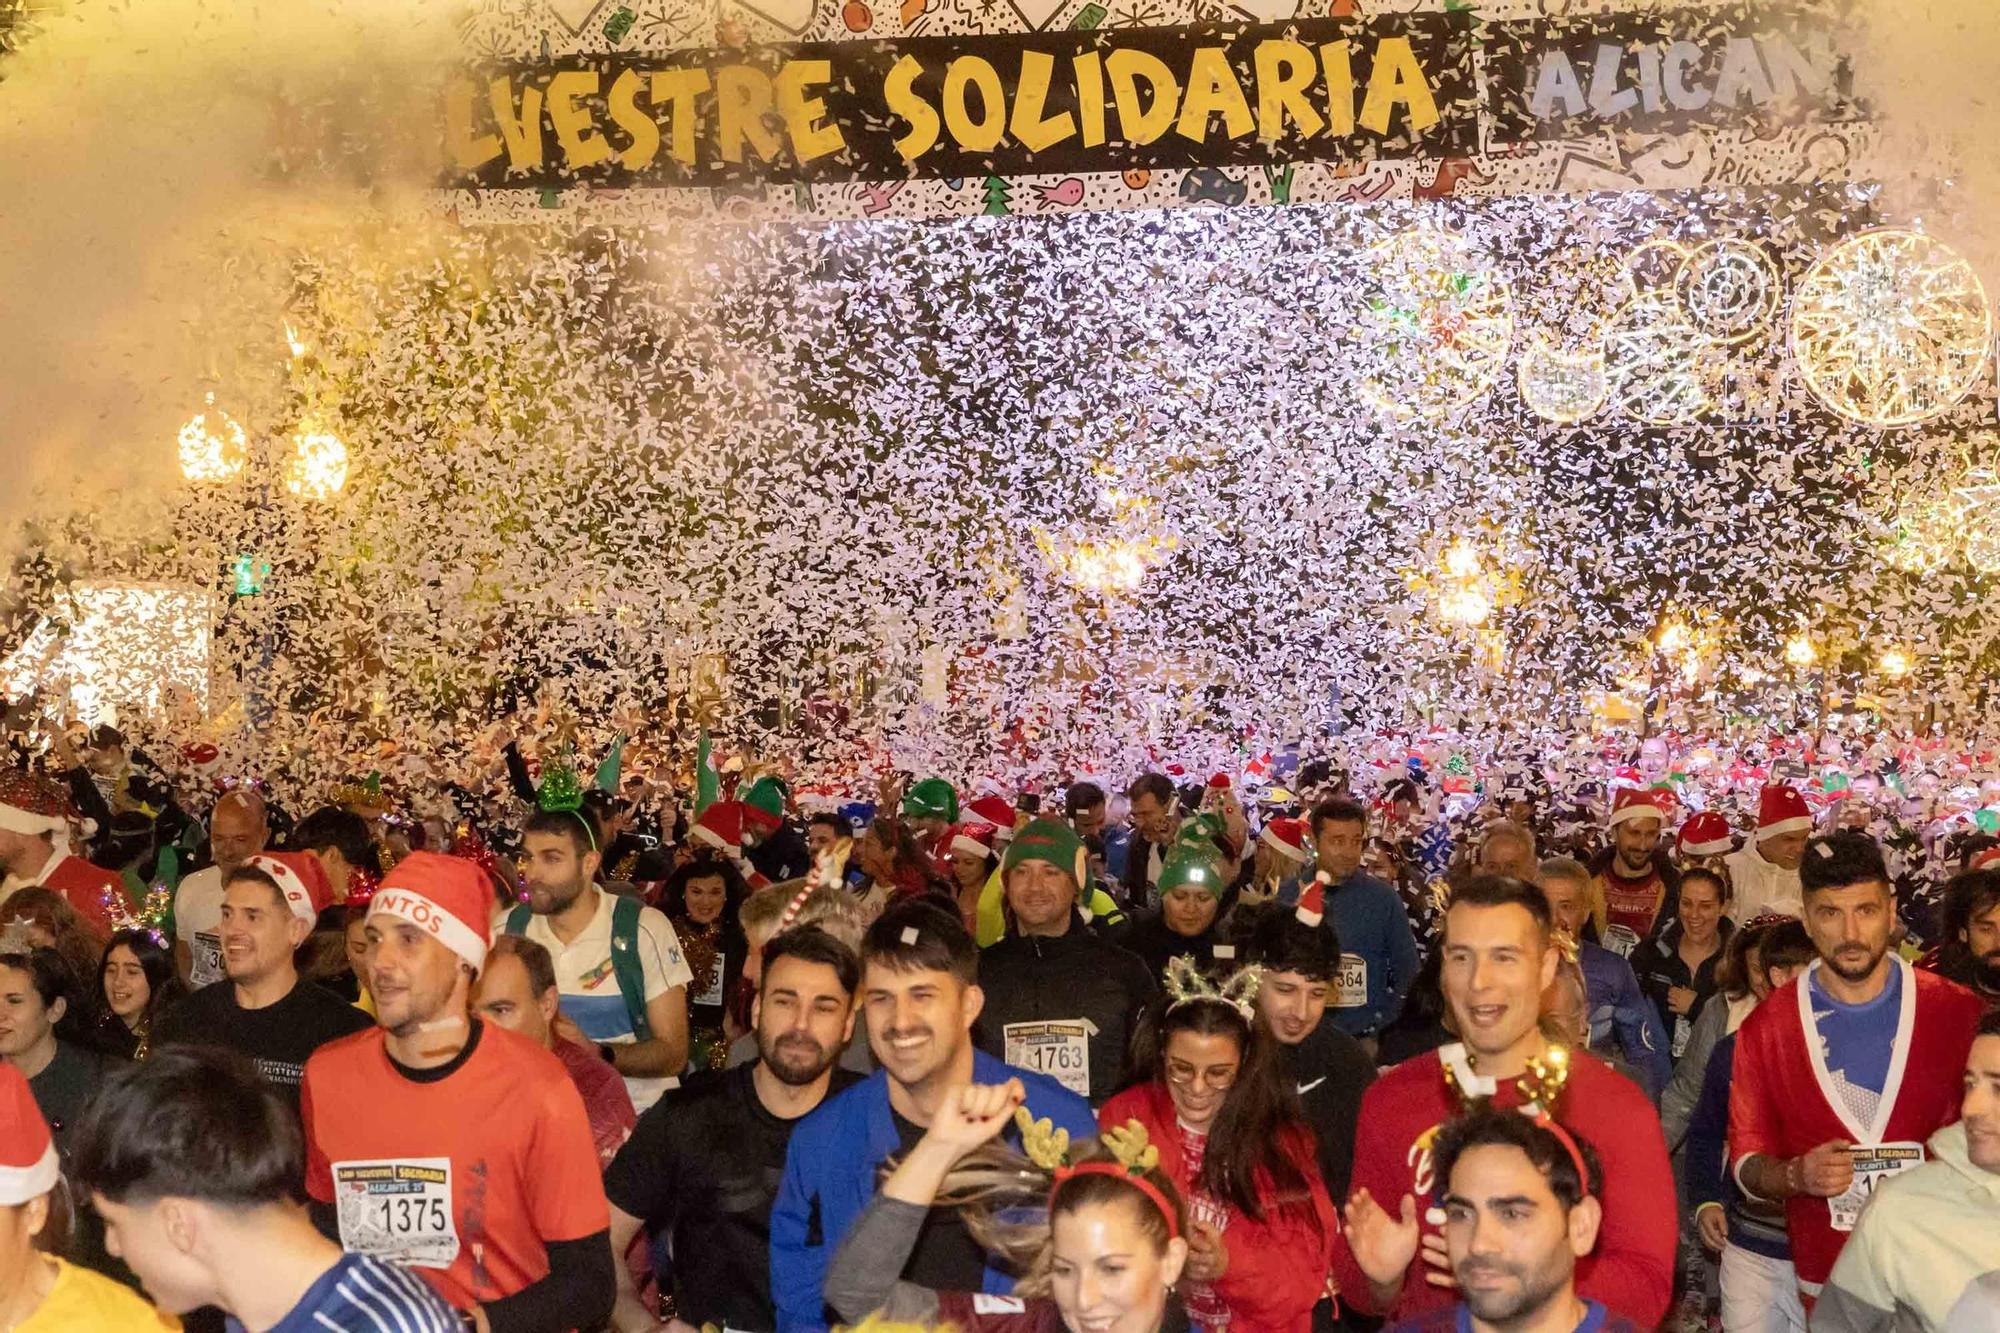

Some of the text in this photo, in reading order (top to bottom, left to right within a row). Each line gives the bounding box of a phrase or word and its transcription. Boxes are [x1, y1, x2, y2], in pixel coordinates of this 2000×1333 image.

[884, 37, 1441, 161] SOLIDARIA
[1034, 1046, 1083, 1071] 1763
[381, 1198, 446, 1233] 1375
